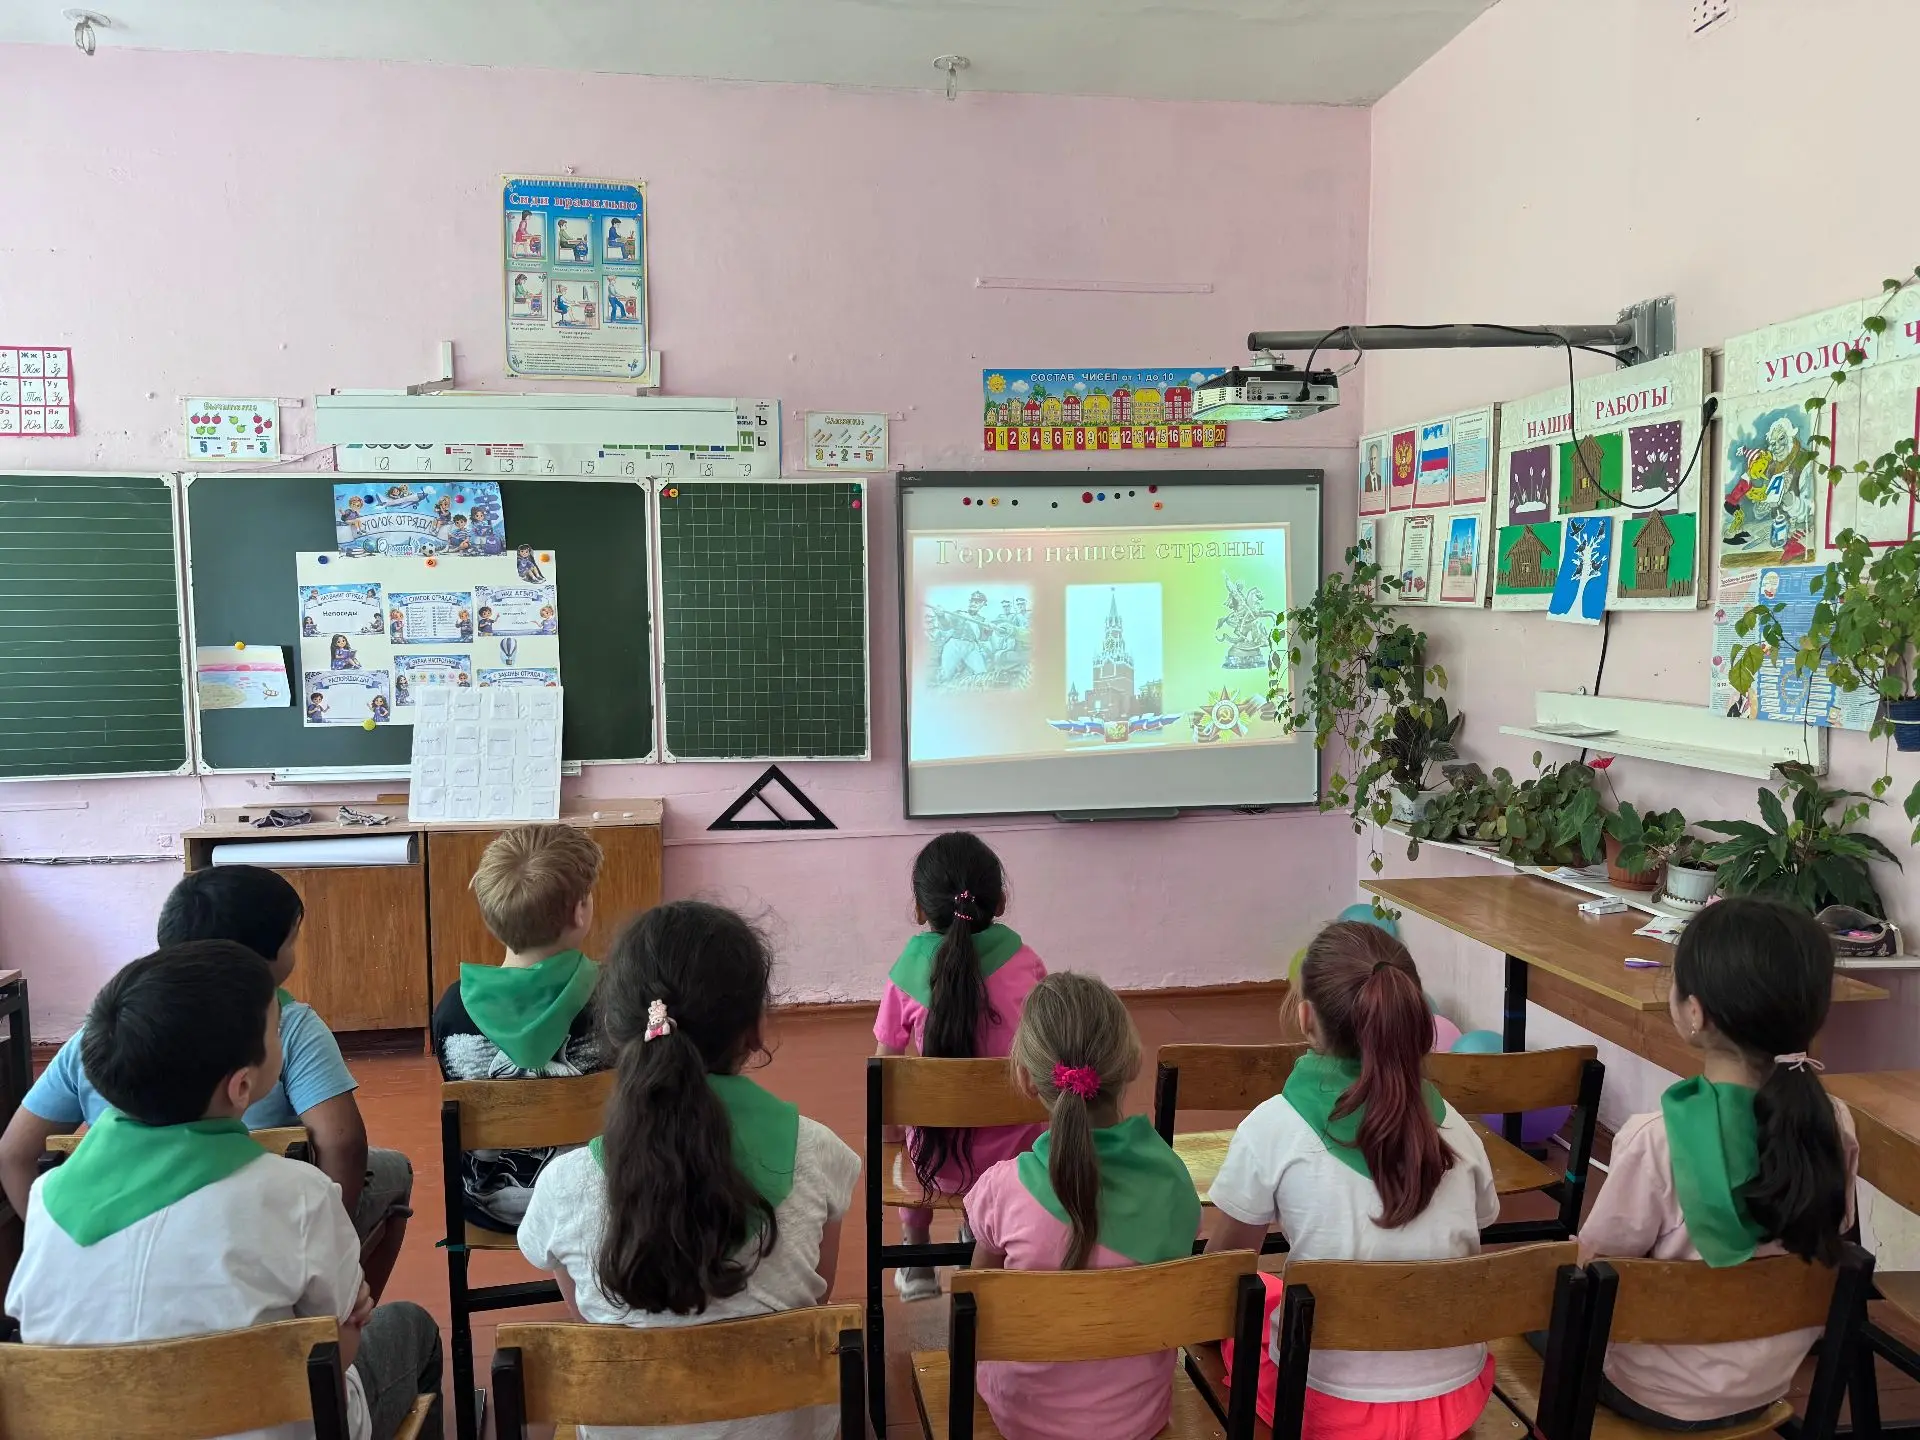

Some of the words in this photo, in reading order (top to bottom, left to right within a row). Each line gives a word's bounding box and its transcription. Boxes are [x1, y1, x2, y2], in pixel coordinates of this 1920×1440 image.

[509, 192, 549, 208] Сиди
[554, 196, 638, 210] правильно
[1030, 373, 1075, 382] СОСТАВ
[1081, 372, 1118, 382] ЧИСЕЛ
[1137, 373, 1142, 381] 1
[1146, 374, 1159, 382] до
[1162, 372, 1174, 381] 10
[1527, 413, 1574, 438] НАШИ
[1595, 385, 1668, 420] РАБОТЫ
[987, 431, 994, 445] 0
[1000, 431, 1005, 445] 1
[1010, 431, 1017, 445] 2
[1020, 431, 1028, 445] 3
[1032, 431, 1039, 445] 4
[1043, 431, 1051, 445] 5
[1054, 431, 1062, 445] 6
[1065, 431, 1073, 445] 7
[1076, 431, 1084, 445] 8
[1087, 431, 1095, 445] 9
[1097, 431, 1108, 445] 10
[1109, 431, 1120, 445] 11
[1120, 430, 1132, 444] 12
[1133, 430, 1143, 444] 13
[1144, 430, 1156, 444] 14
[1156, 430, 1167, 444] 15
[1168, 429, 1179, 443] 16
[1180, 429, 1191, 443] 17
[1192, 429, 1203, 443] 18
[1203, 428, 1214, 442] 19
[1215, 428, 1226, 442] 20
[200, 440, 208, 453] 5
[230, 440, 238, 453] 2
[259, 441, 268, 454] 3
[841, 448, 849, 462] 2
[865, 449, 874, 463] 5
[1766, 475, 1785, 496] А
[361, 515, 394, 532] УГОЛОК
[936, 539, 1033, 569] Герои
[1044, 536, 1146, 563] нашей
[1155, 539, 1266, 564] страны
